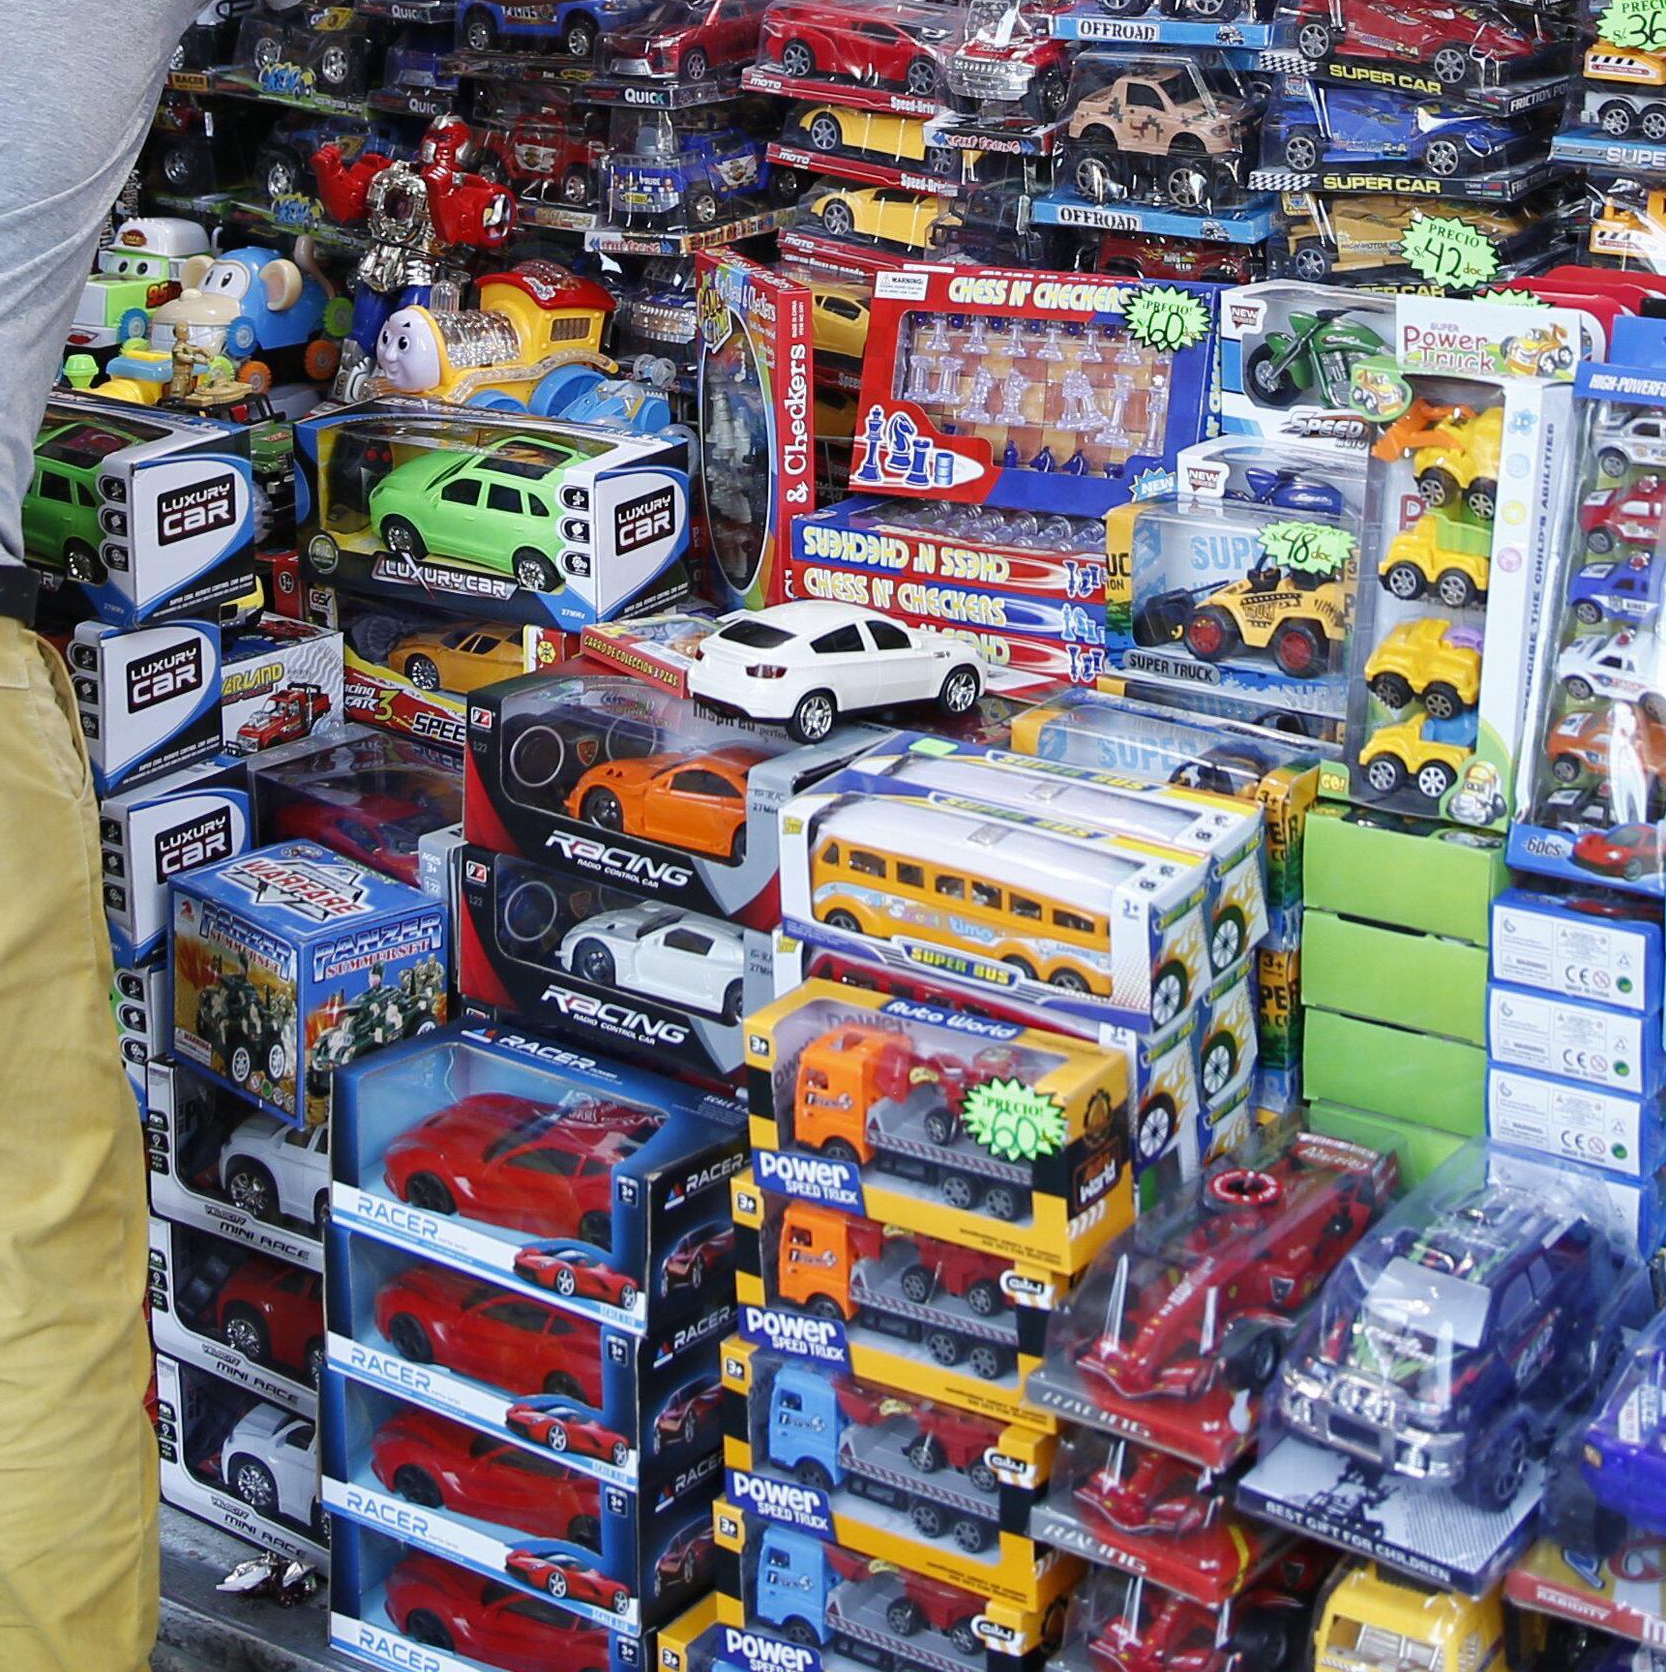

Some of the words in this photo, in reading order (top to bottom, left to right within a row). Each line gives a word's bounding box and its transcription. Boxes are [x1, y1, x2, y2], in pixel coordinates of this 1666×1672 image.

[1078, 21, 1156, 40] OFFROAD
[624, 87, 666, 105] QUICK
[1329, 63, 1397, 88] SUPER
[1400, 77, 1442, 96] CAR
[1402, 324, 1489, 352] Power
[1418, 347, 1495, 374] Truck
[784, 343, 807, 476] Checkers
[161, 482, 230, 512] LUXURY
[617, 495, 671, 524] LUXURY
[786, 482, 809, 504] &
[381, 558, 456, 590] LUXURY
[458, 573, 509, 598] CAR
[131, 648, 196, 680] LUXURY
[1129, 653, 1171, 672] SUPER
[1173, 661, 1213, 682] TRUCK
[158, 814, 227, 848] LUXURY
[312, 912, 444, 968] PANZER
[325, 939, 431, 979] SUMMERSET
[910, 947, 967, 977] SUPER
[973, 964, 1009, 984] BUS
[886, 1000, 945, 1024] Auto
[947, 1008, 1018, 1040] World
[499, 1033, 601, 1072] RACER
[784, 1177, 819, 1199] SPEED
[820, 1183, 859, 1207] TRUCK
[356, 1194, 440, 1241] RACER
[218, 1220, 258, 1238] MINI
[259, 1234, 312, 1260] RACE
[771, 1335, 807, 1356] SPEED
[807, 1340, 847, 1362] TRUCK
[215, 1361, 252, 1379] MINI
[253, 1375, 300, 1403] RACE
[349, 1345, 432, 1394] RACER
[345, 1488, 429, 1537] RACER
[756, 1502, 791, 1523] SPEED
[792, 1508, 830, 1531] TRUCK
[222, 1513, 262, 1534] MINI
[262, 1532, 308, 1560] RACE
[1265, 1500, 1304, 1520] BEST
[1375, 1539, 1451, 1583] CHILDREN
